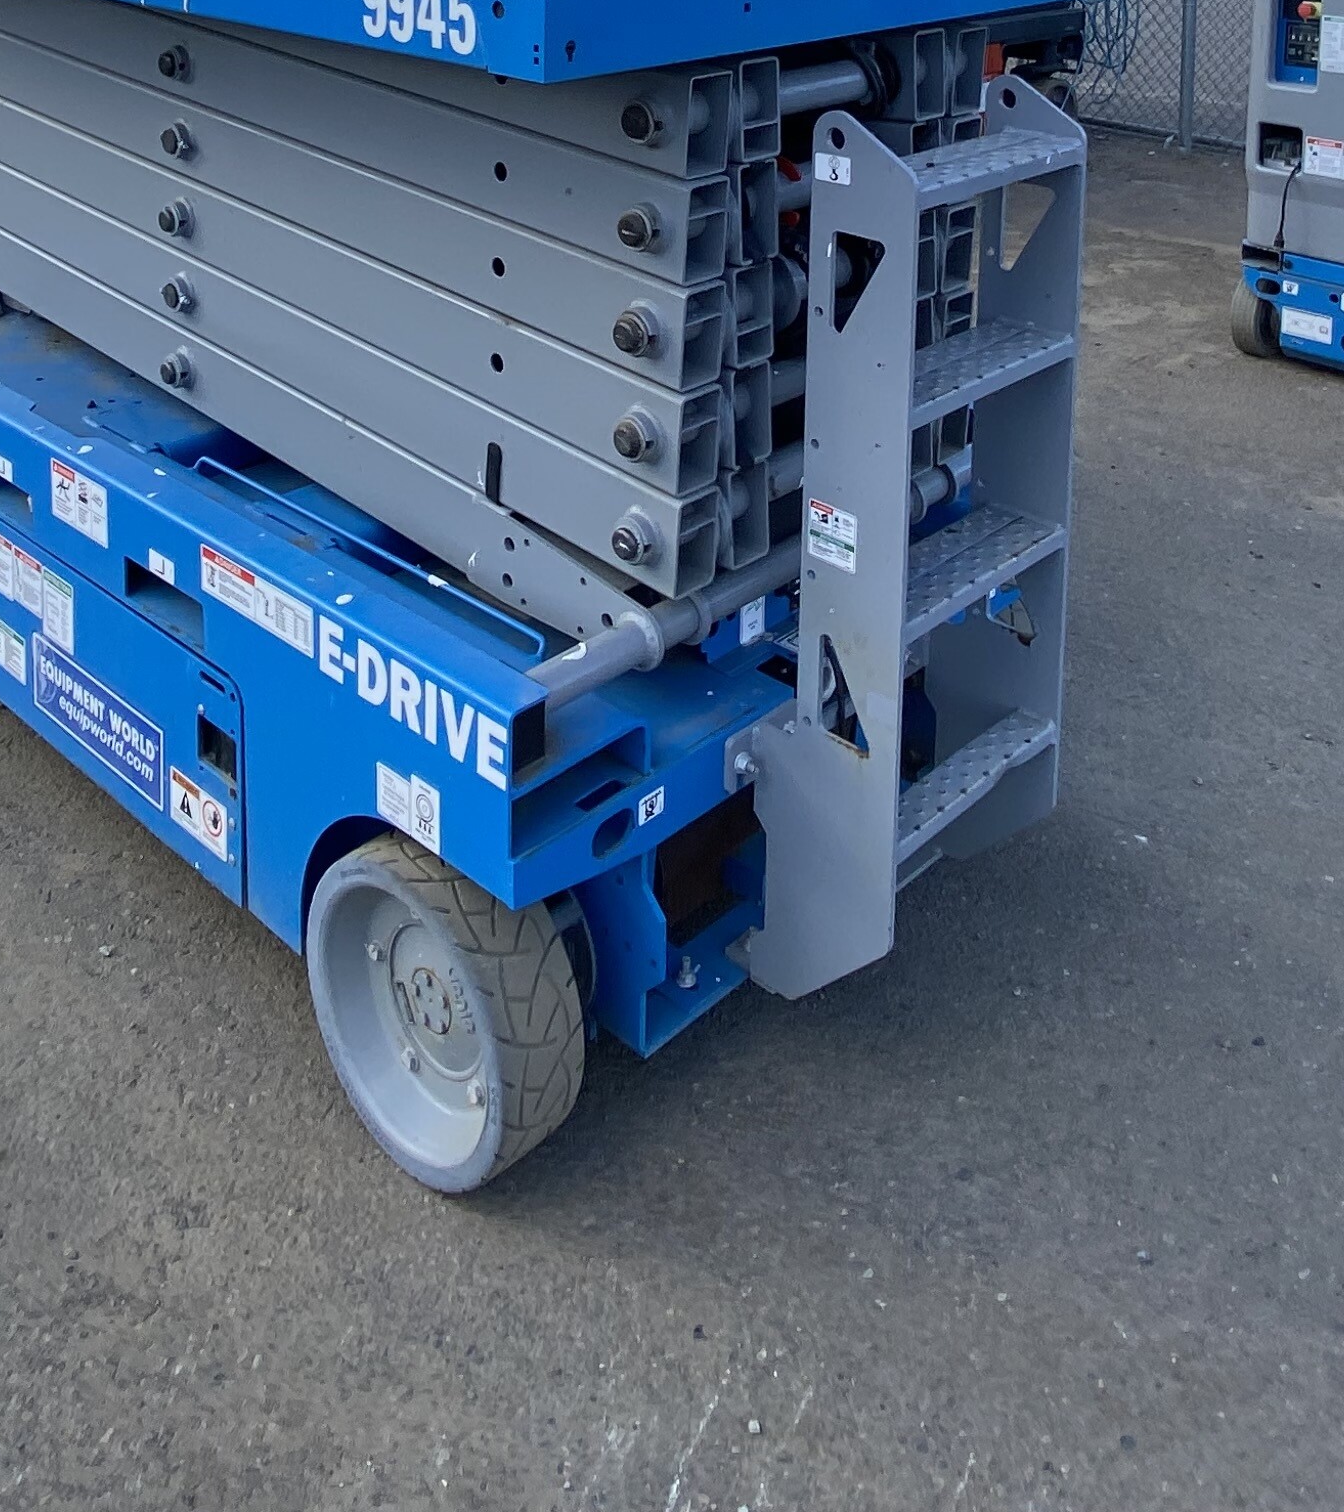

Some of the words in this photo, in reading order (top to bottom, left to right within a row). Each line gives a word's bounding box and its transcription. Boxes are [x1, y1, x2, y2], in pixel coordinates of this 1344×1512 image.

[40, 655, 106, 721] EQUIPMENT
[109, 709, 156, 762] WORLD
[58, 696, 154, 782] equipworld.com
[319, 614, 508, 791] E-DRIVE
